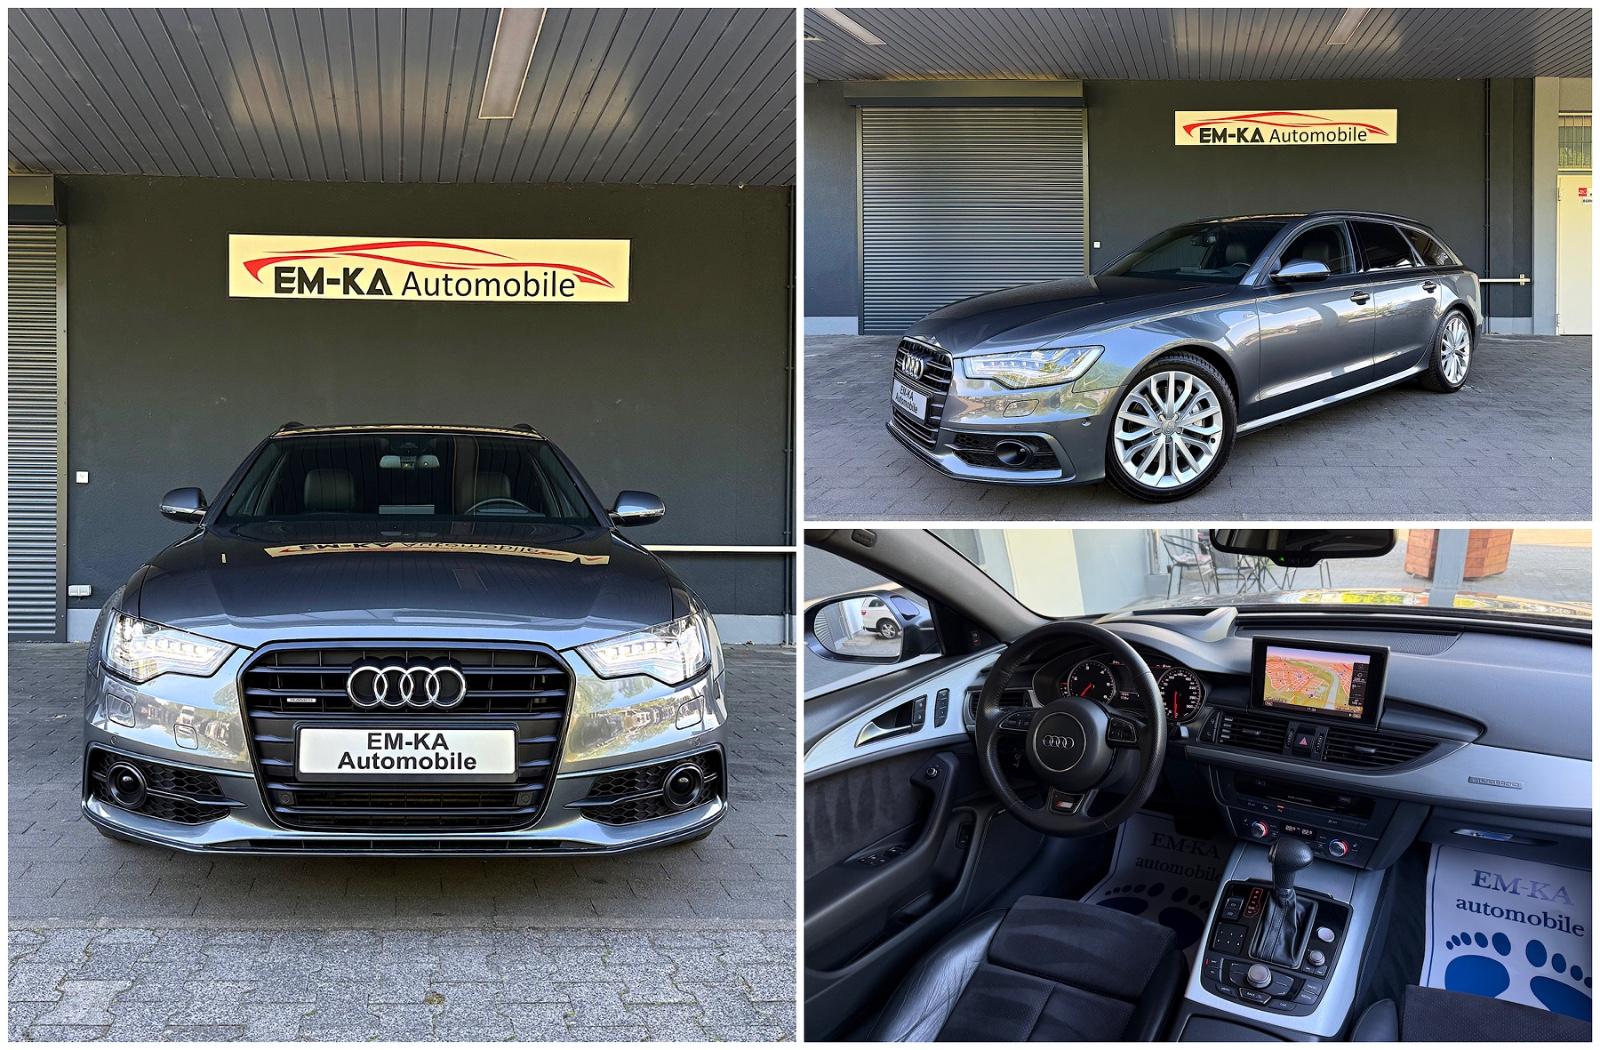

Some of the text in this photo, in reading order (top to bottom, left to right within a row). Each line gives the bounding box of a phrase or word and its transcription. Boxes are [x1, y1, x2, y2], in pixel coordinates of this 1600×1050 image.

[1200, 126, 1367, 143] EM-KA Automobile
[273, 266, 576, 297] EM-KA Automobile
[366, 732, 450, 751] EM-KA
[337, 751, 478, 771] Automobile
[1151, 832, 1220, 859] EM-KA
[1471, 869, 1575, 906] EM-KA
[1456, 898, 1585, 937] automobile
